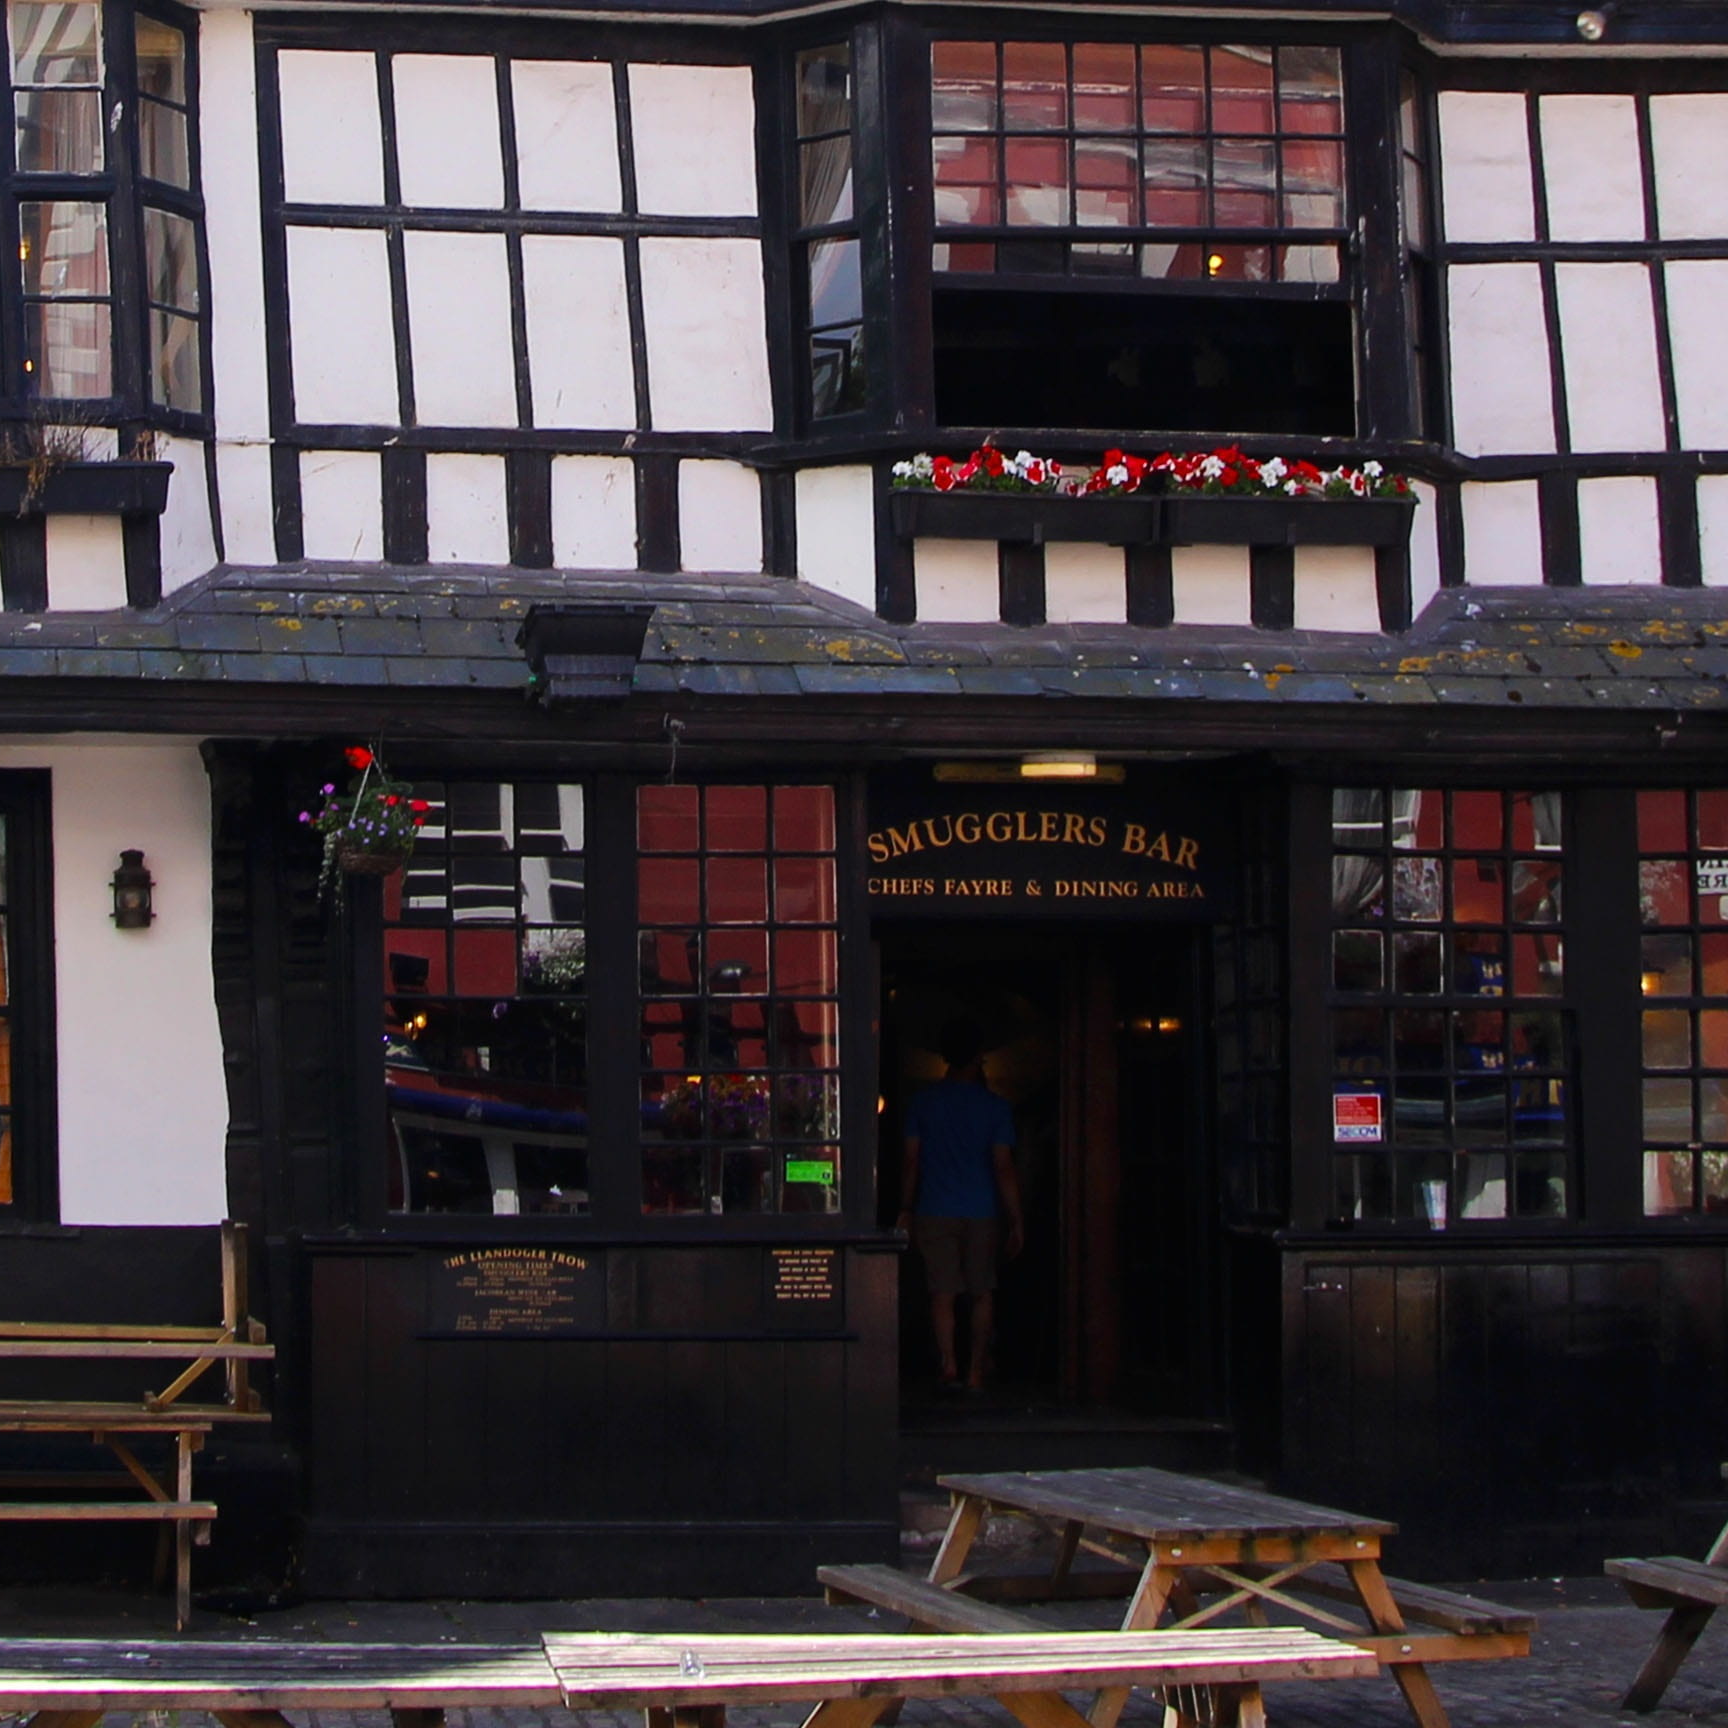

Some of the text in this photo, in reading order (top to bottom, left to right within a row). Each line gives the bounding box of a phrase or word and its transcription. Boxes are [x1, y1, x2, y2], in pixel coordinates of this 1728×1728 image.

[867, 811, 1200, 870] SMUGGLERS BAR
[867, 877, 1206, 898] CHEFS FAYRE & DINING AREA
